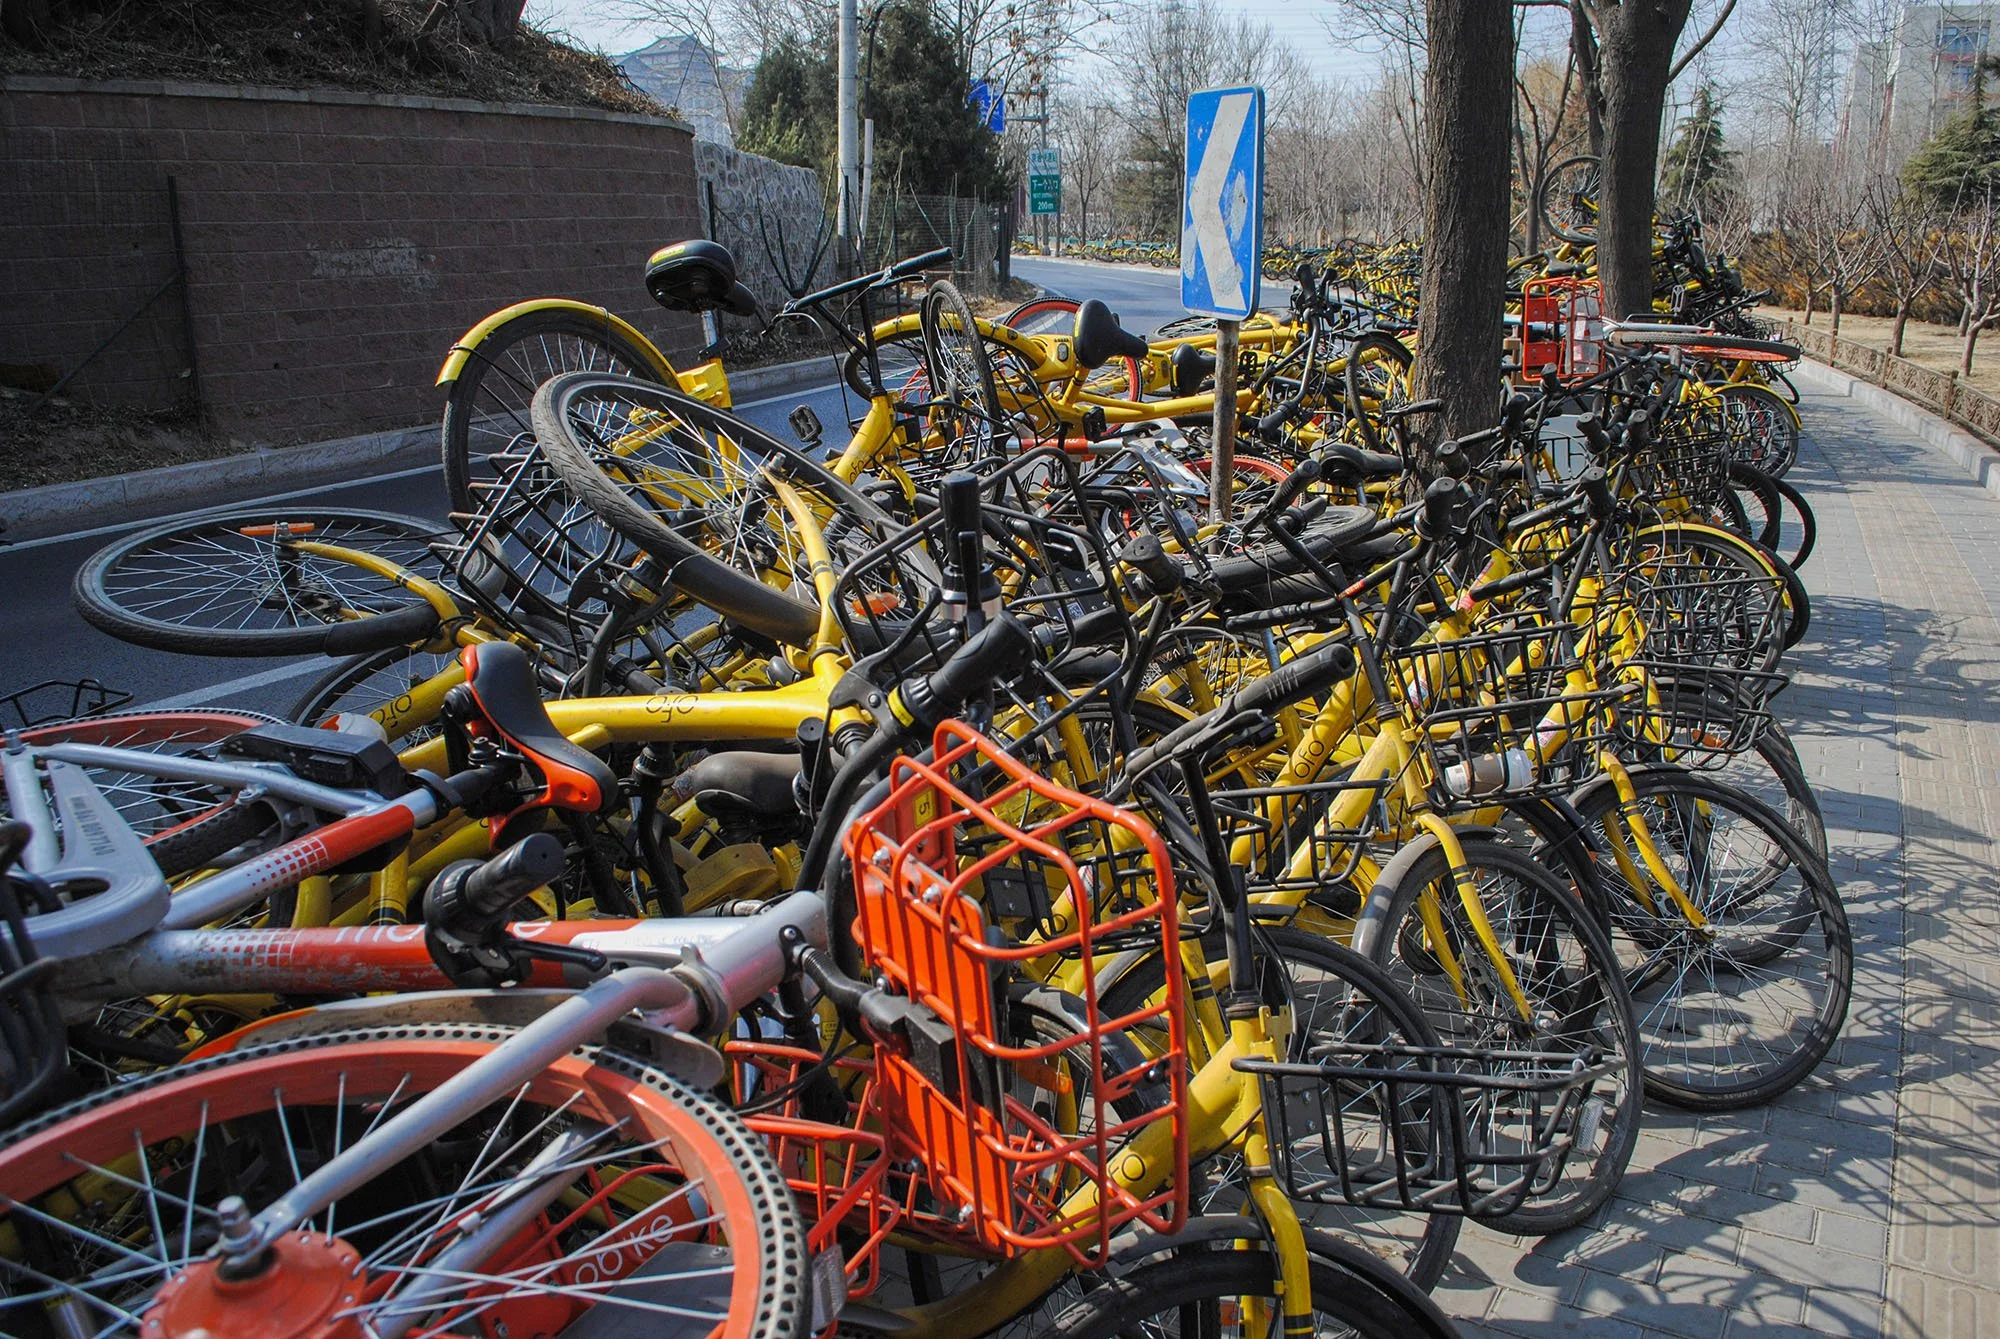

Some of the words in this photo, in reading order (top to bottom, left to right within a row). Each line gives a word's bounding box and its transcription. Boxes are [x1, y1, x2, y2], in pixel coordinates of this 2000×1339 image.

[1037, 201, 1054, 210] 200m
[646, 695, 698, 723] ofo
[1294, 740, 1324, 778] ofo
